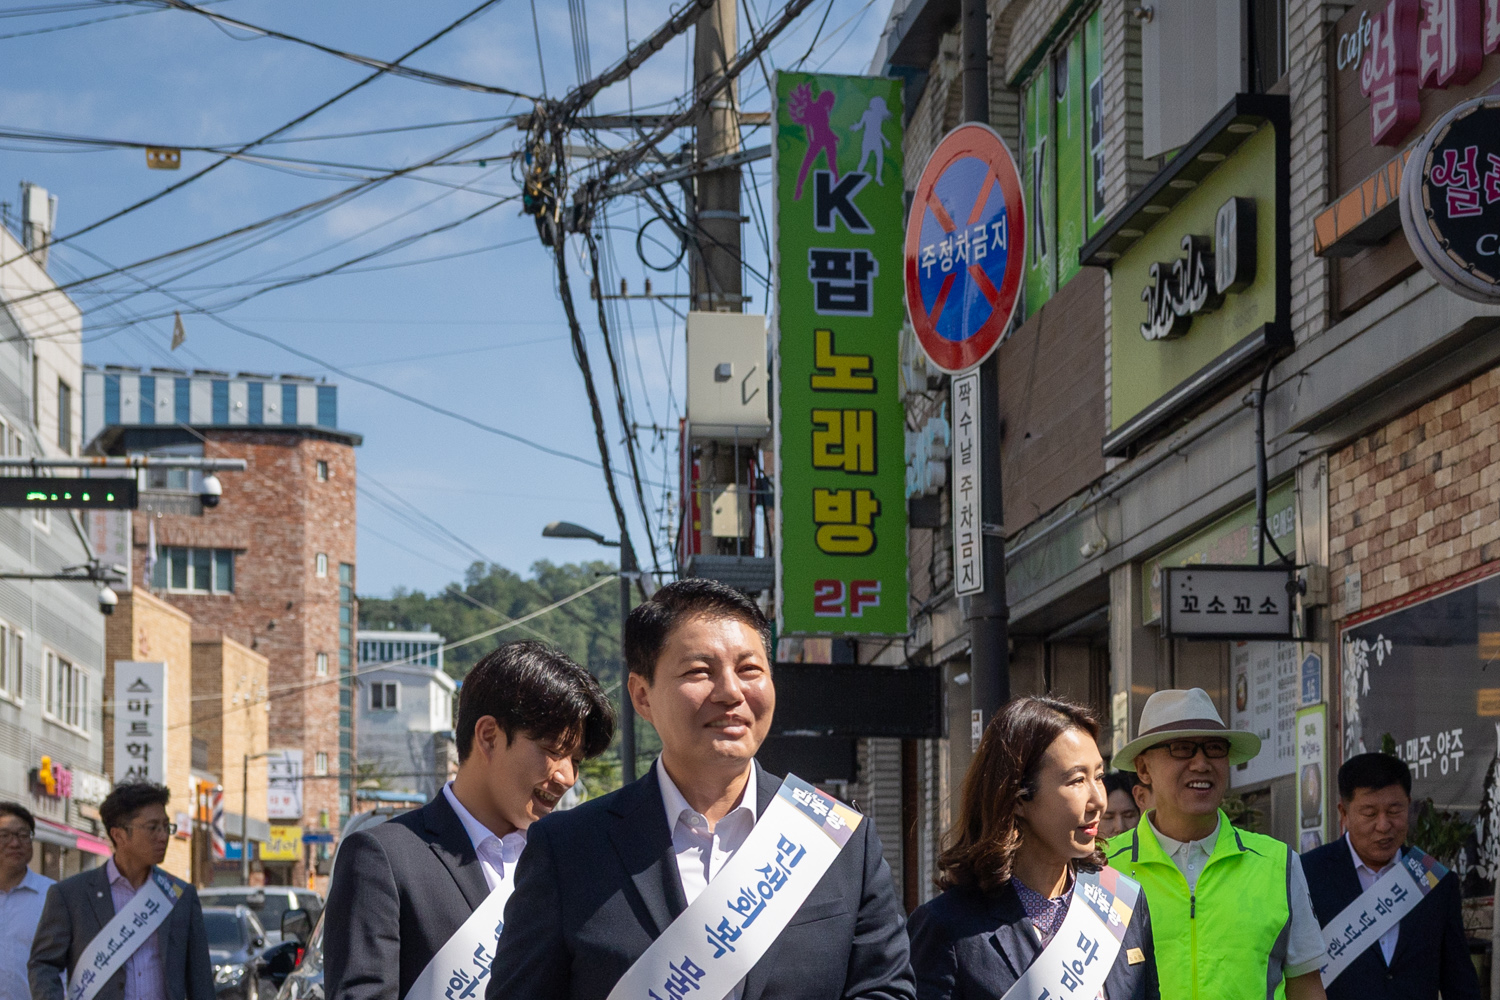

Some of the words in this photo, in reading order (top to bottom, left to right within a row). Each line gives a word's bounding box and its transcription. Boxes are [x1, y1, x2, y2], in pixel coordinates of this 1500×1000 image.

[1337, 10, 1371, 71] Cafe
[921, 214, 1008, 277] 주정차금지
[810, 329, 879, 557] 노래방
[957, 381, 973, 465] 짝수날
[959, 474, 975, 586] 주차금지
[813, 579, 881, 618] 2F
[1180, 594, 1280, 616] 꼬소꼬소
[791, 786, 848, 831] 민주당
[704, 832, 808, 960] 민생회복
[1083, 882, 1123, 928] 민주당
[1374, 882, 1409, 917] 마음
[93, 925, 136, 971] 넉넉한
[1059, 930, 1100, 993] 마음
[1326, 910, 1378, 961] 넉넉한
